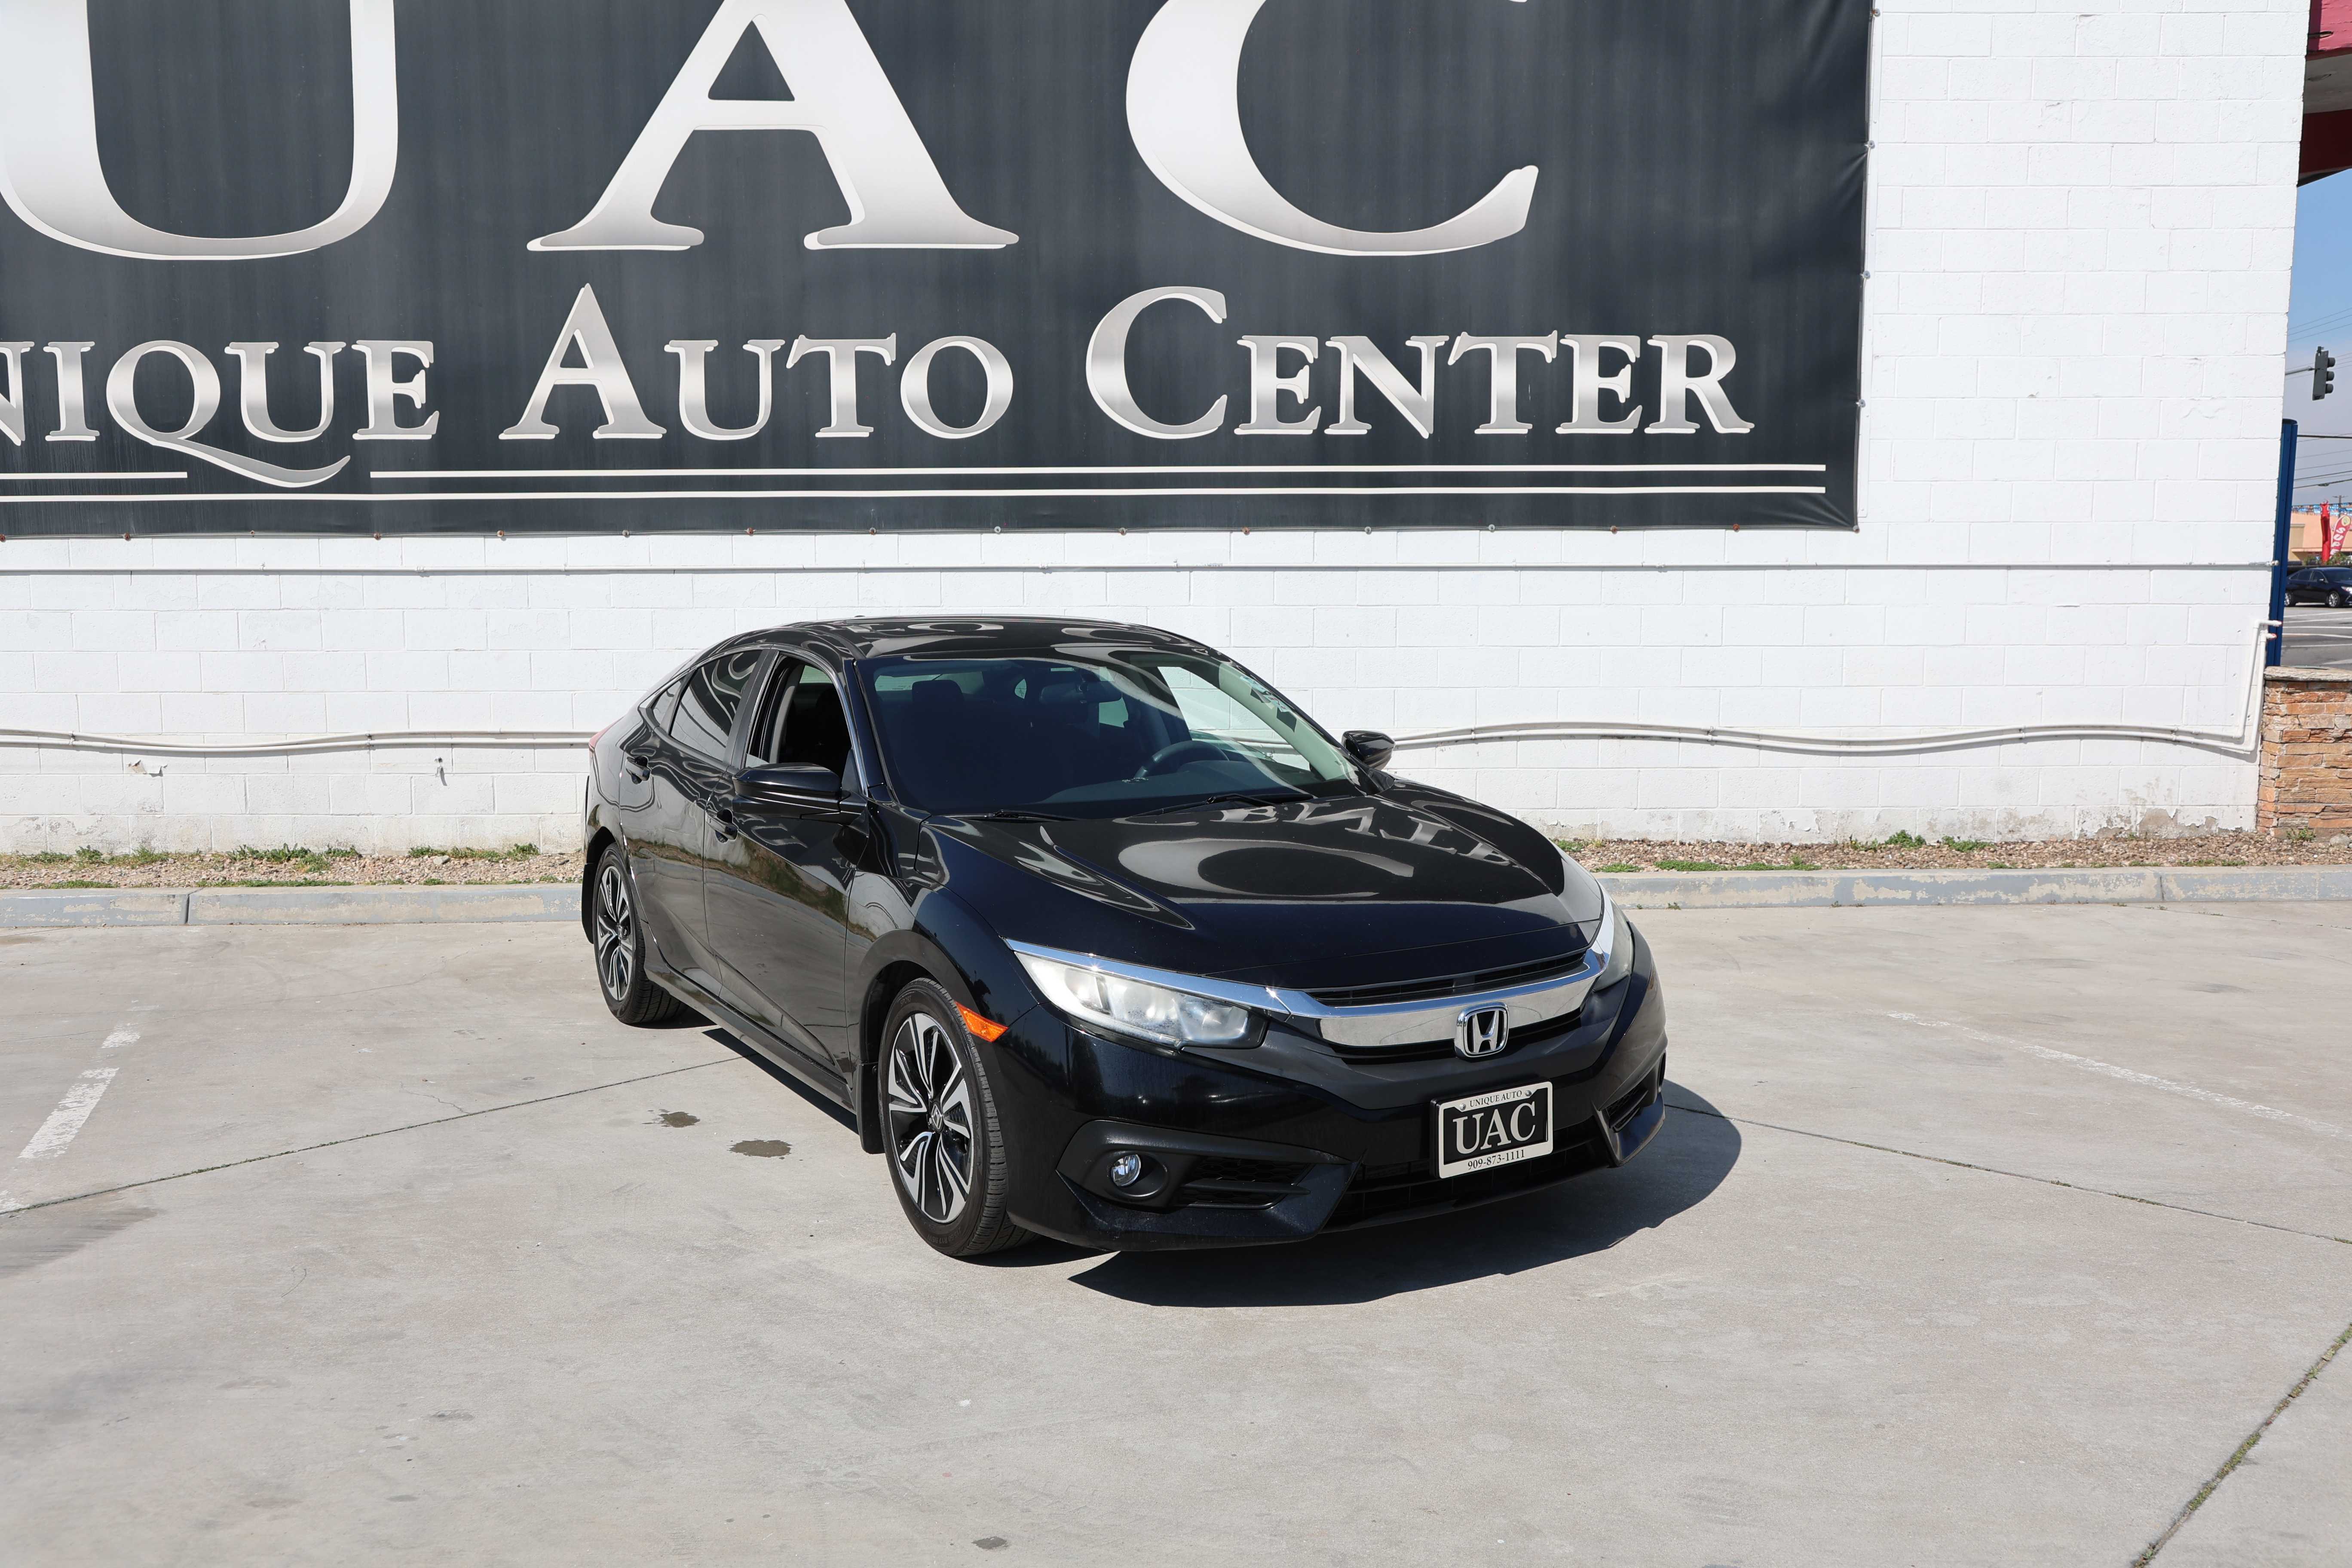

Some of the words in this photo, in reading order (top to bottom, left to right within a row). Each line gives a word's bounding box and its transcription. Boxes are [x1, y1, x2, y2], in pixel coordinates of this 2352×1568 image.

[0, 340, 439, 487] IQUE
[499, 283, 1014, 440] AUTO
[1085, 286, 1755, 440] CENTER
[1470, 1095, 1500, 1108] UNIQUE
[1501, 1090, 1522, 1101] AUTO
[1453, 1101, 1536, 1154] UAC
[1467, 1149, 1525, 1170] 909-873-1111
